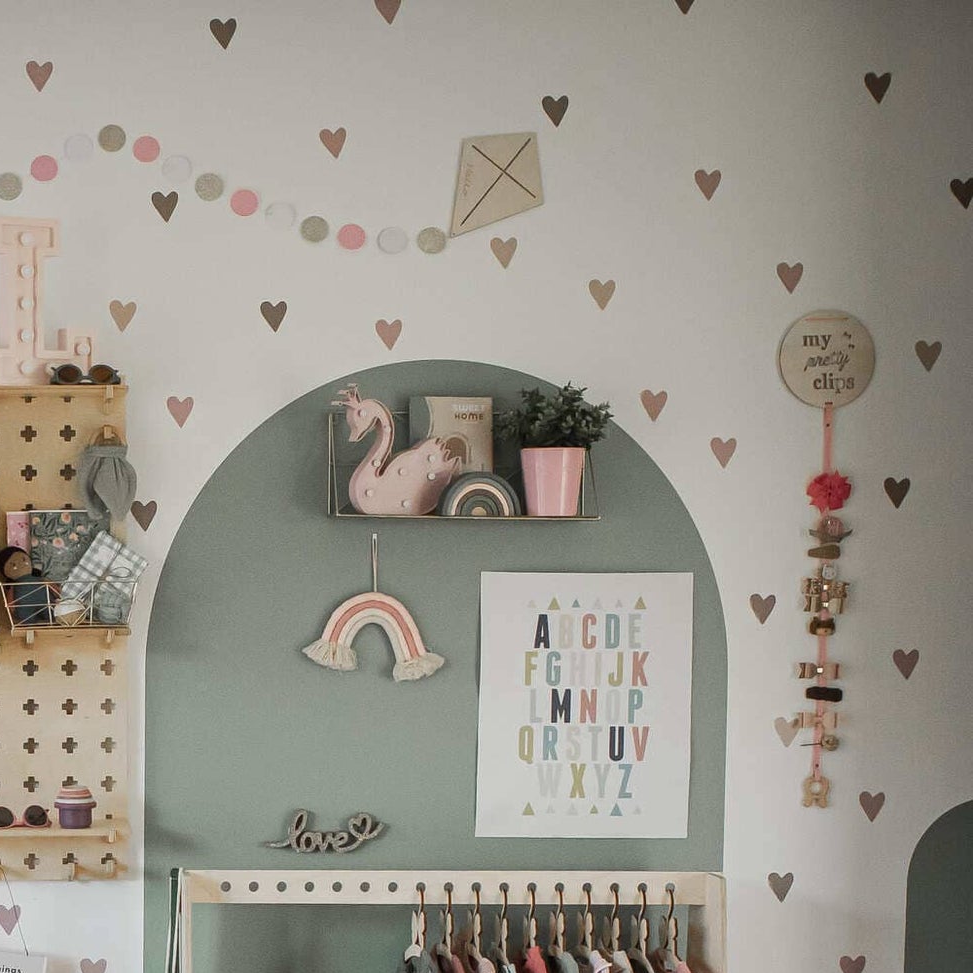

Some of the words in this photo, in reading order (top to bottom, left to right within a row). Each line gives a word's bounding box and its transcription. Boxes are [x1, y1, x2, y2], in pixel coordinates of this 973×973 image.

[803, 334, 832, 350] my
[804, 350, 850, 371] pretty
[813, 373, 855, 393] clips
[268, 808, 384, 853] love
